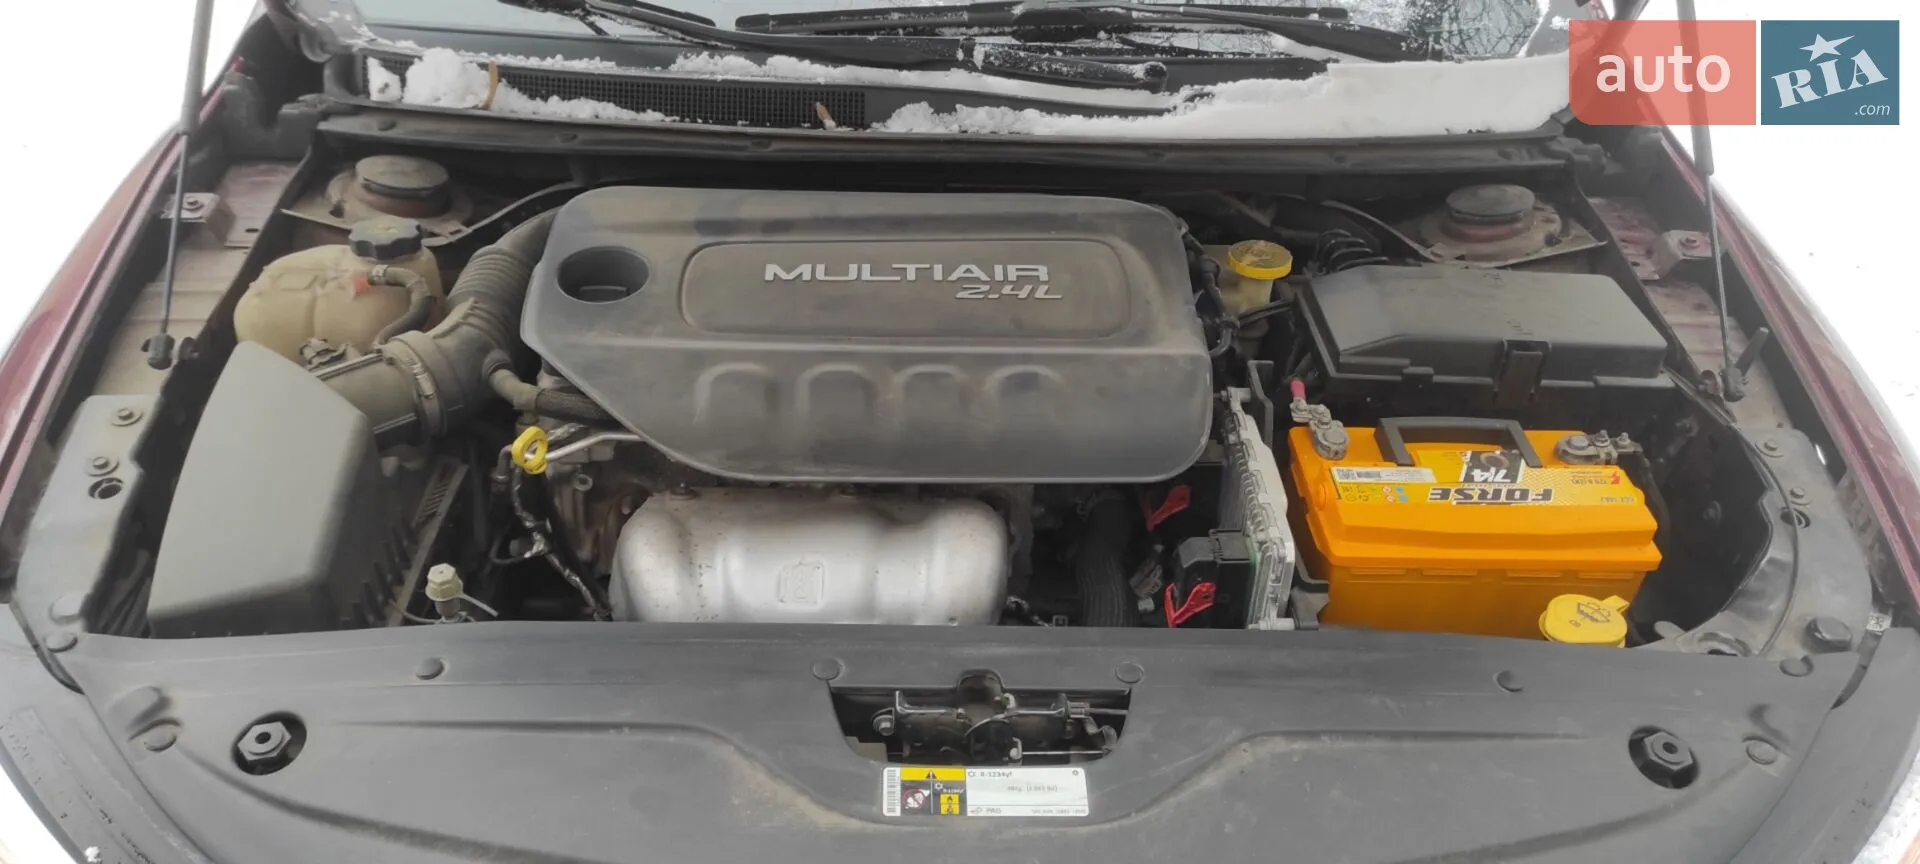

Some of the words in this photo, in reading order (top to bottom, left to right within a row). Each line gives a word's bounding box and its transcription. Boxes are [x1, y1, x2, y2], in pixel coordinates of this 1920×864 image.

[764, 263, 1049, 281] MULTIAIR
[955, 284, 1063, 299] 2.4L
[1429, 487, 1553, 502] FORSE
